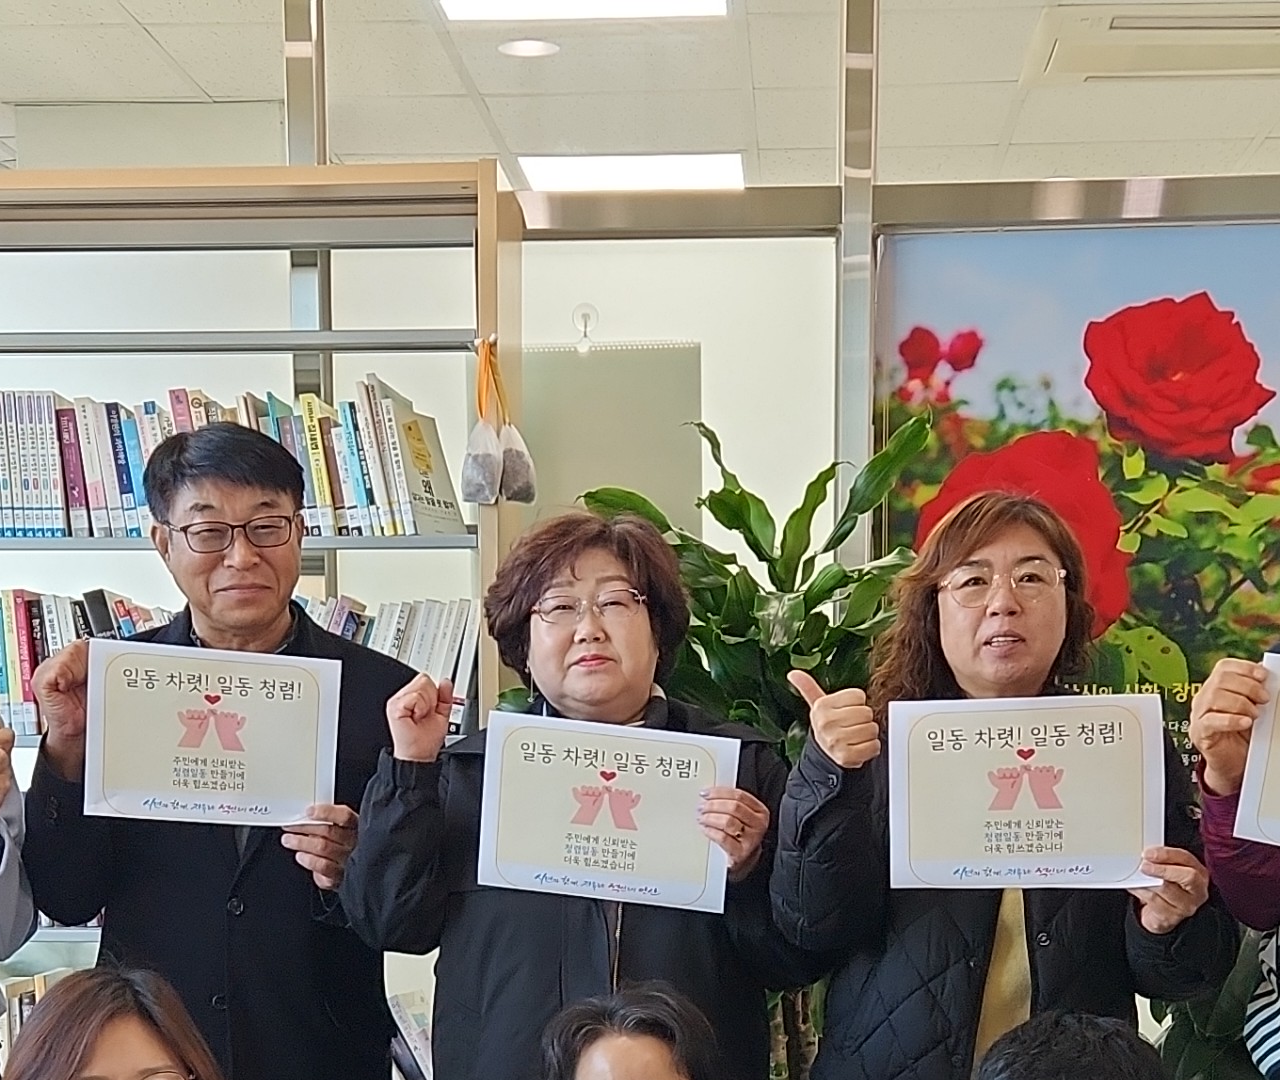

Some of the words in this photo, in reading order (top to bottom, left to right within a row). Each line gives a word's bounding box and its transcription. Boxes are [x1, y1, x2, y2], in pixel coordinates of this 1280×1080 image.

[123, 668, 160, 689] 일동
[165, 672, 209, 692] 차렷!
[218, 676, 253, 696] 일동
[259, 679, 302, 700] 청렴!
[928, 729, 967, 751] 일동
[974, 726, 1022, 749] 차렷!
[1030, 724, 1070, 747] 일동
[1077, 722, 1123, 744] 청렴!
[173, 757, 207, 766] 주민에게
[211, 758, 246, 769] 신뢰받는
[520, 742, 556, 763] 일동
[563, 747, 606, 768] 차렷!
[614, 752, 649, 774] 일동
[656, 757, 698, 778] 청렴!
[173, 768, 207, 777] 청렴일동
[210, 769, 244, 780] 만들기에
[173, 779, 189, 788] 더욱
[193, 780, 244, 791] 힘쓰겠습니다
[984, 820, 1021, 830] 주민에게
[1025, 819, 1064, 829] 신뢰받는
[984, 832, 1021, 841] 청렴일동
[1025, 830, 1064, 840] 만들기에
[984, 844, 1003, 853] 더욱
[1006, 842, 1063, 853] 힘쓰겠습니다
